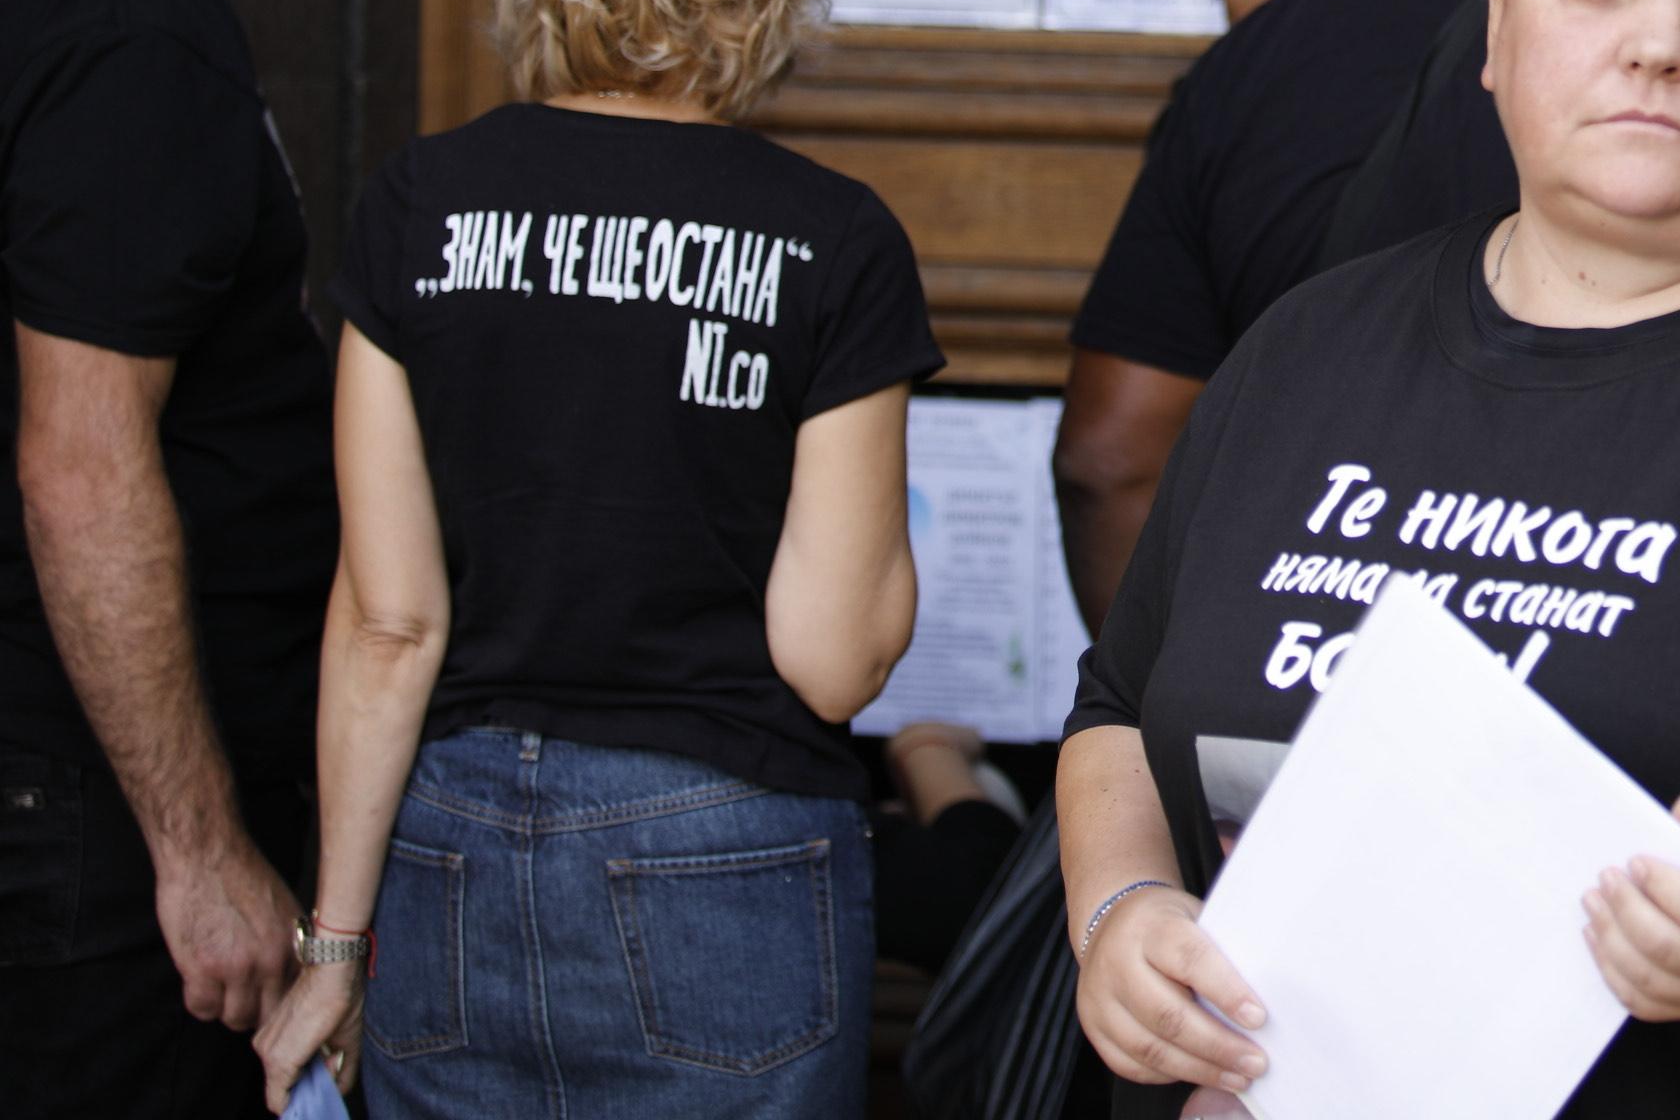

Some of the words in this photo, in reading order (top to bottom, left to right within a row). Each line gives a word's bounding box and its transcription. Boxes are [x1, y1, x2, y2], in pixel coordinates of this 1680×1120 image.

[543, 214, 589, 295] ЧЕ
[1306, 464, 1387, 538] Те
[1462, 578, 1635, 637] станат
